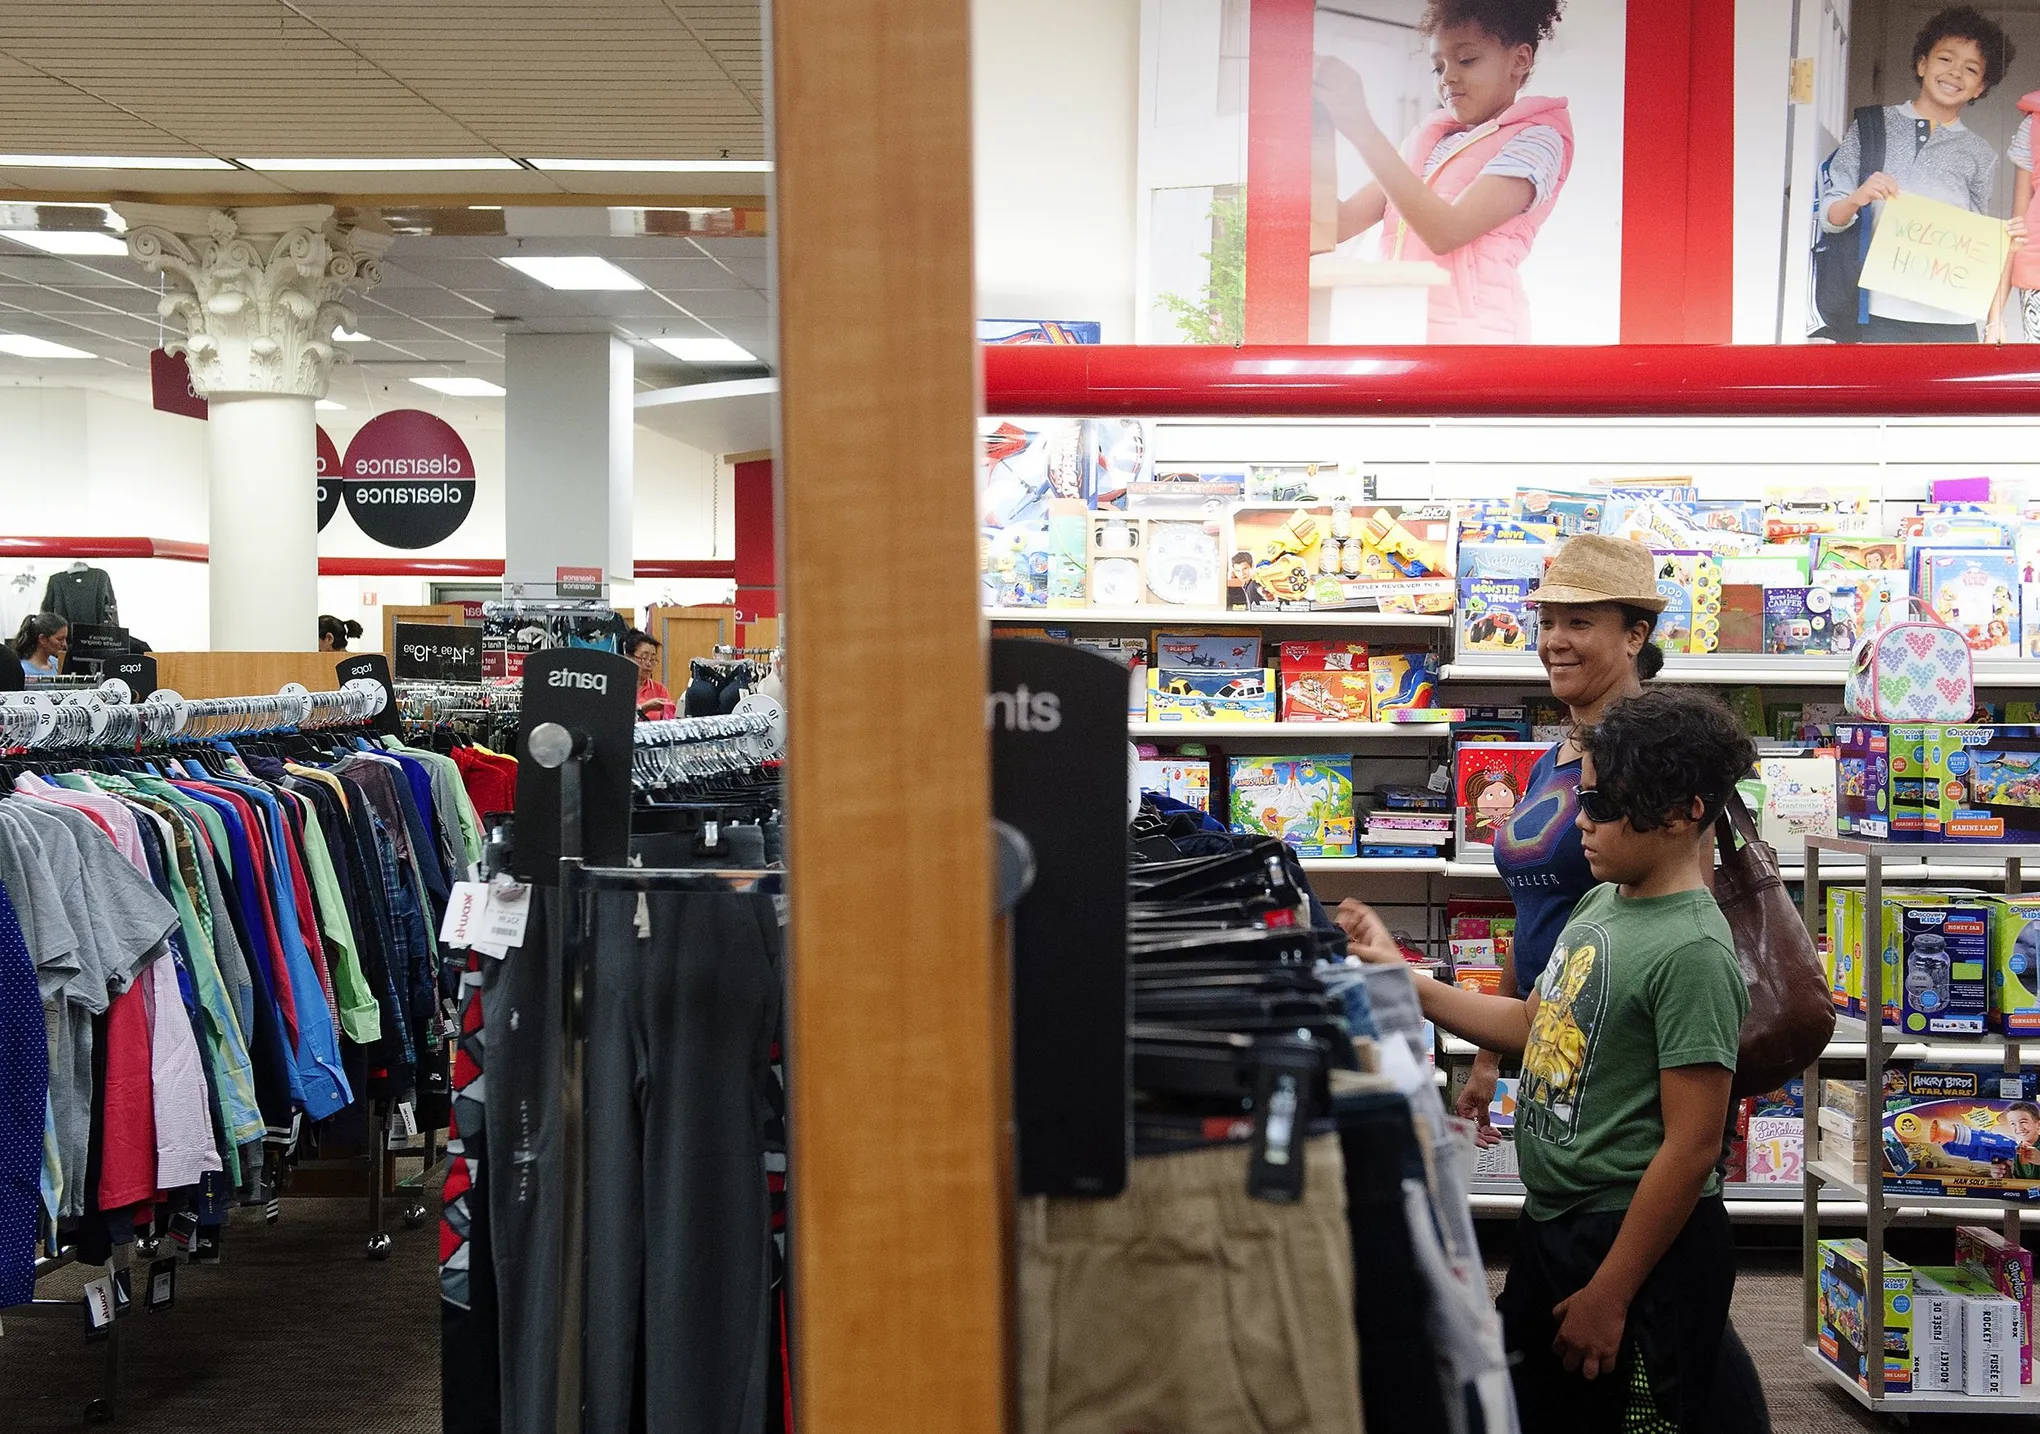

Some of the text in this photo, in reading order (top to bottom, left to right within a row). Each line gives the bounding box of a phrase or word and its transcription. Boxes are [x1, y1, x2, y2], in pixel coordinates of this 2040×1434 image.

[1497, 531, 1525, 540] DRIVE
[1471, 584, 1520, 594] MONSTER
[1486, 594, 1520, 603] TRUCK
[1777, 801, 1823, 809] Grandmother
[1913, 1076, 1973, 1088] ANGRY BIRDS
[1944, 1088, 1972, 1096] WARS
[1770, 1140, 1781, 1169] 1
[1780, 1151, 1800, 1181] 2
[1933, 1302, 1942, 1341] FUSÉE DE
[1983, 1311, 1991, 1344] ROCKET
[1940, 1351, 1949, 1383] ROCKET
[1990, 1354, 2000, 1393] FUSÉE DE
